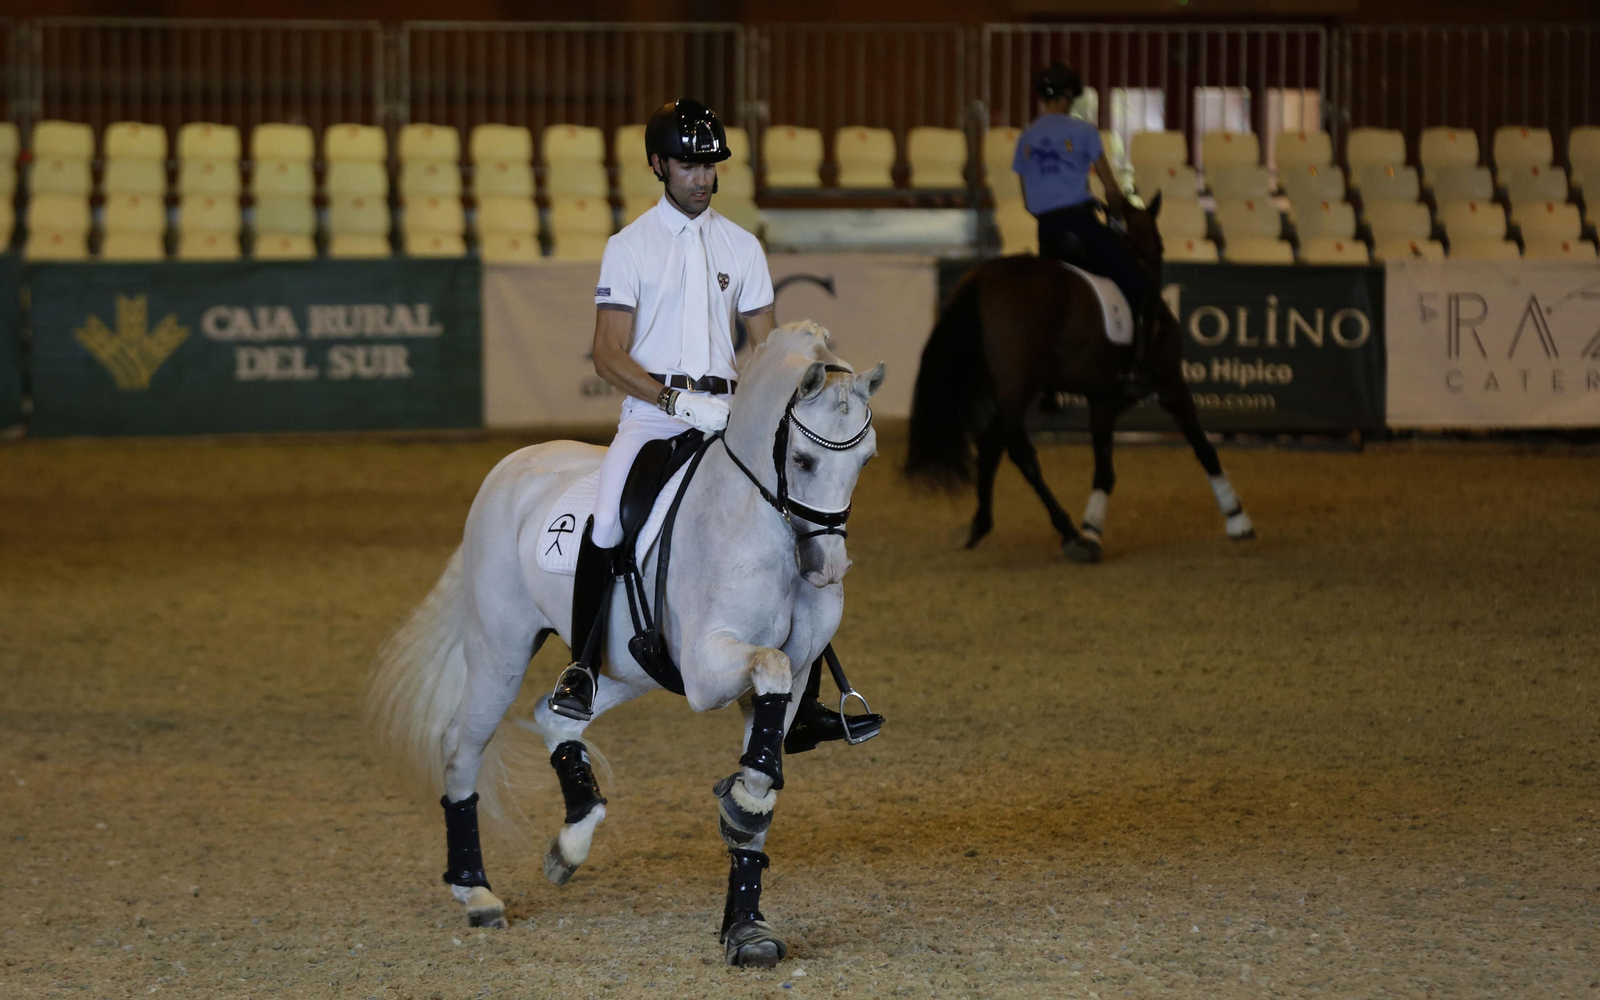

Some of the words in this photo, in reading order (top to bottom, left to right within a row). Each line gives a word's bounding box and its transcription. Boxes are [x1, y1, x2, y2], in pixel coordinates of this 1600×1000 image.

[202, 304, 300, 340] CAJA
[308, 303, 443, 338] RURAL
[235, 346, 317, 381] DEL
[328, 345, 413, 379] SUR
